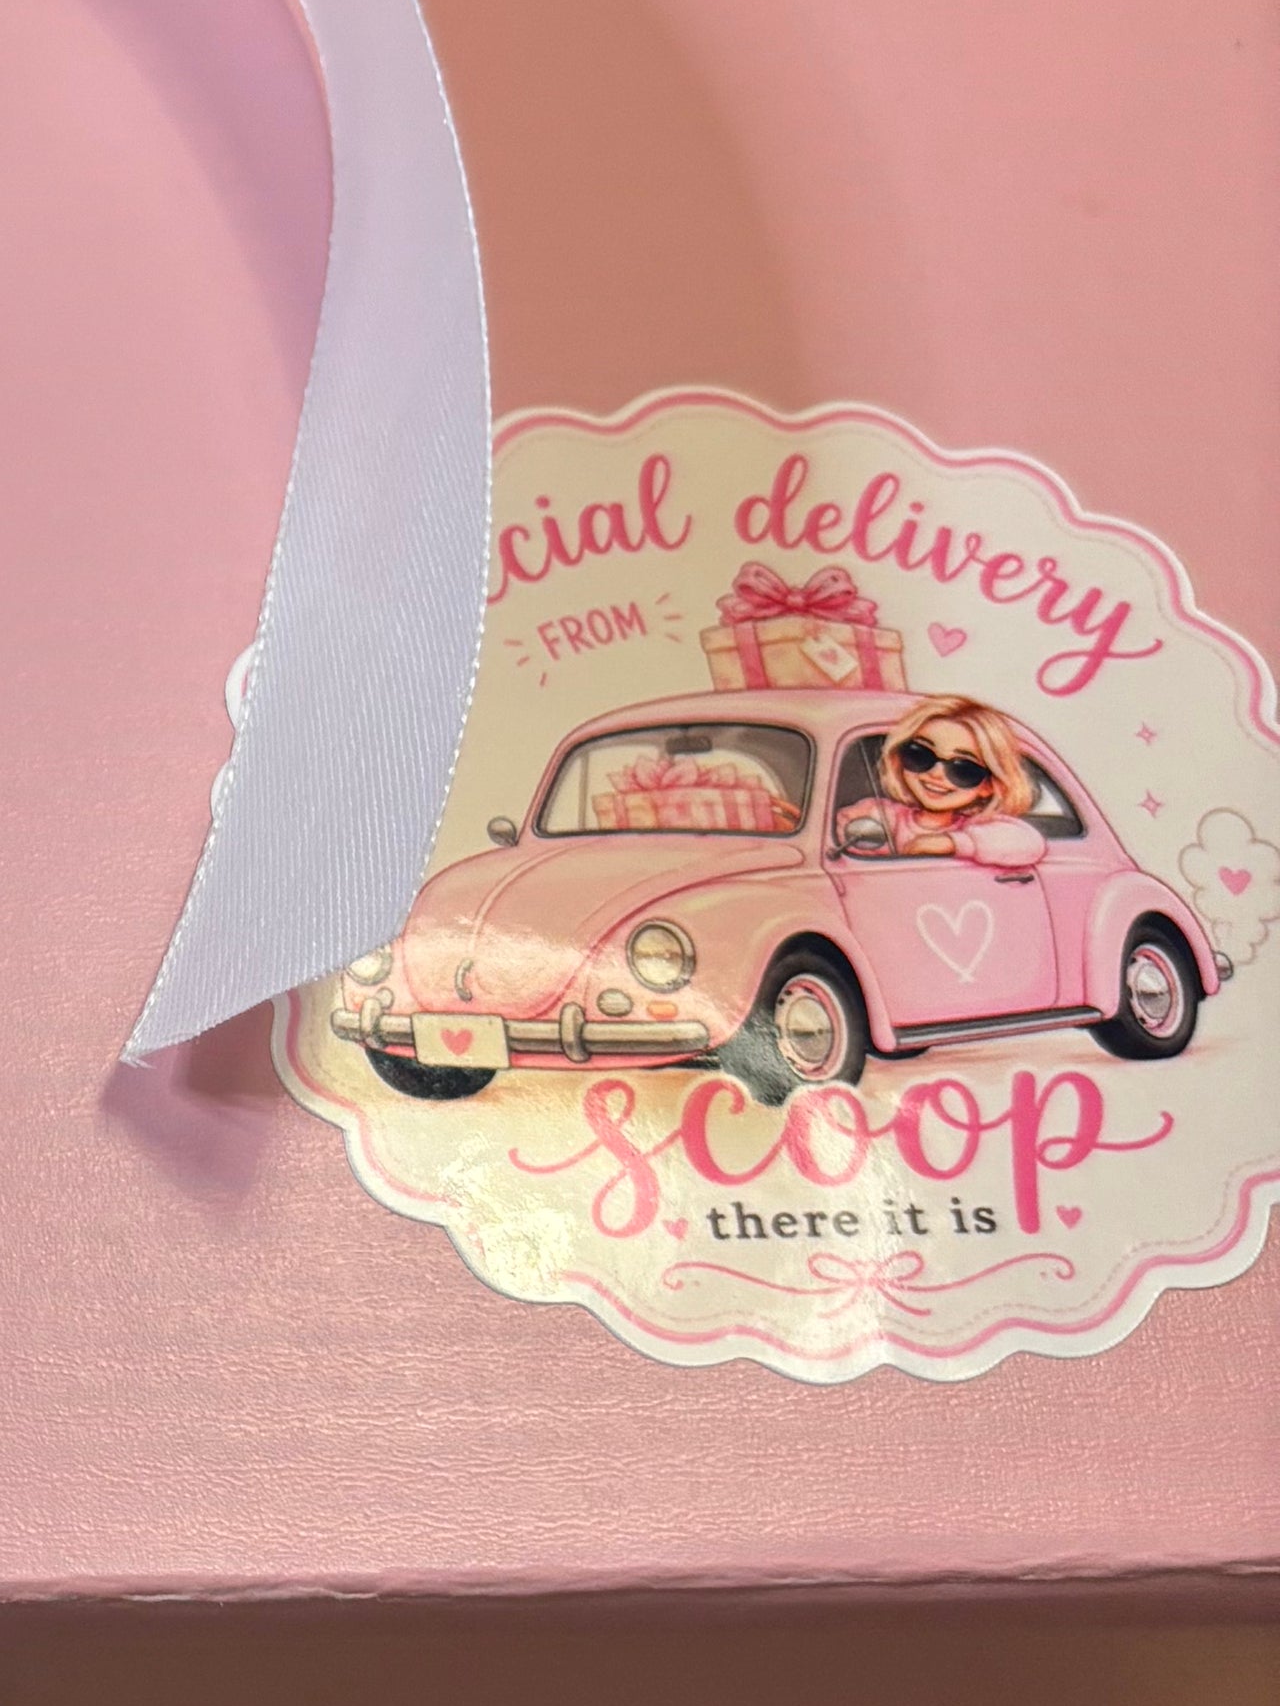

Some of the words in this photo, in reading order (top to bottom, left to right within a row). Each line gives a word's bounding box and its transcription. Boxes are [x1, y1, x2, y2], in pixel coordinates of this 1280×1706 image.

[486, 453, 692, 605] cial
[734, 453, 1164, 697] delivery
[537, 601, 648, 661] FROM
[706, 1201, 860, 1240] there
[883, 1197, 928, 1235] it
[949, 1196, 998, 1234] is
